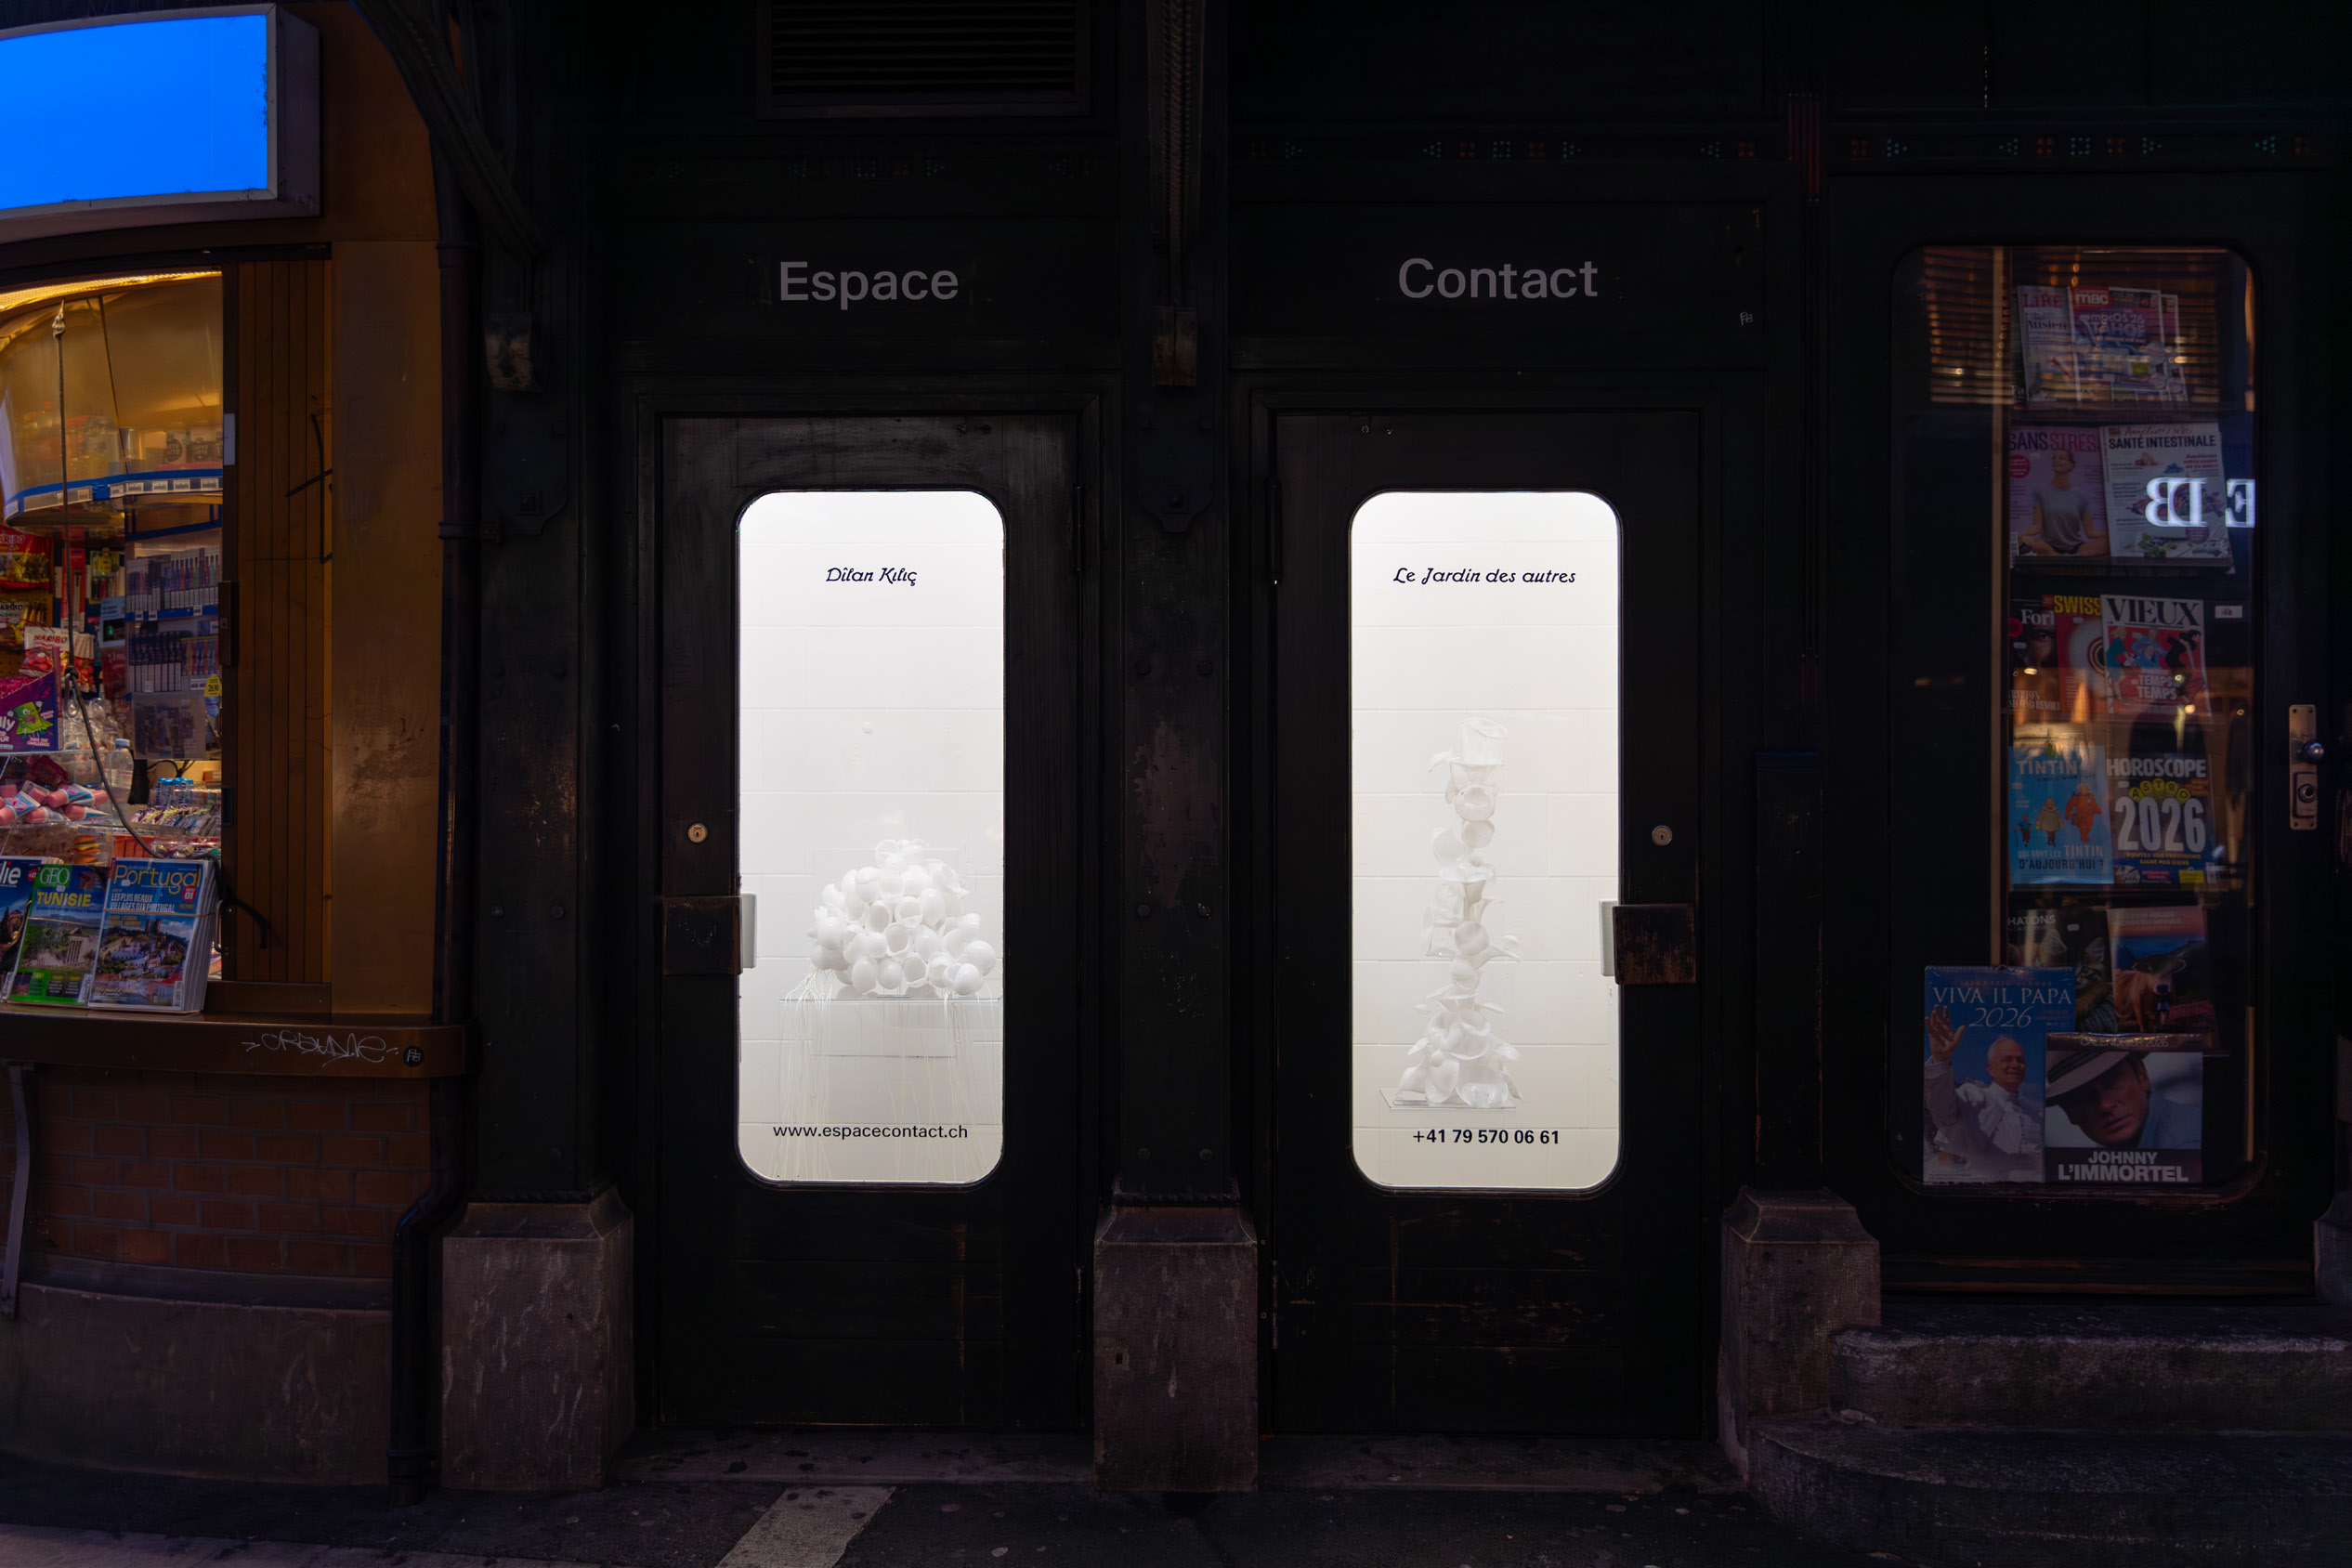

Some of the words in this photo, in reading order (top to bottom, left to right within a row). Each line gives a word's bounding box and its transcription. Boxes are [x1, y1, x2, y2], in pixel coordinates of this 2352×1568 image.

[780, 261, 959, 310] Espace
[1398, 257, 1598, 299] Contact
[2075, 292, 2110, 305] mac
[2009, 432, 2048, 451] SANS
[2049, 433, 2099, 452] STRES
[2146, 436, 2216, 448] INTESTINALE
[0, 534, 26, 544] ARIBO
[826, 567, 874, 582] Dîlan
[1393, 567, 1416, 584] Le
[1421, 568, 1481, 585] Jardin
[1486, 568, 1516, 583] des
[1522, 568, 1576, 583] autres
[0, 603, 23, 611] ARIBO
[2106, 597, 2202, 626] VIEUX
[33, 634, 68, 644] HARIBO
[2137, 686, 2177, 699] TEMPS
[2016, 760, 2078, 775] TINTIN
[2107, 758, 2206, 777] HOROSCOPE
[2130, 779, 2189, 799] ASTRO
[2115, 796, 2206, 853] 2026
[2063, 844, 2103, 857] TINTIN
[0, 861, 21, 884] lie
[39, 868, 70, 884] GEO
[113, 865, 202, 895] Portugal
[37, 892, 92, 908] TUNISIE
[2008, 915, 2056, 926] HATONS
[1932, 987, 1985, 1004] VIVA
[1993, 987, 2012, 1004] IL
[2021, 987, 2071, 1004] PAPA
[1968, 1006, 2034, 1027] 2026
[773, 1125, 968, 1140] www.espacecontact.ch
[1413, 1129, 1445, 1143] +41
[1452, 1129, 1472, 1143] 79
[1478, 1130, 1509, 1143] 570
[1514, 1130, 1535, 1144] 06
[1540, 1130, 1559, 1144] 61
[2088, 1151, 2158, 1165] JOHNNY
[2058, 1163, 2189, 1182] L'IMMORTEL
